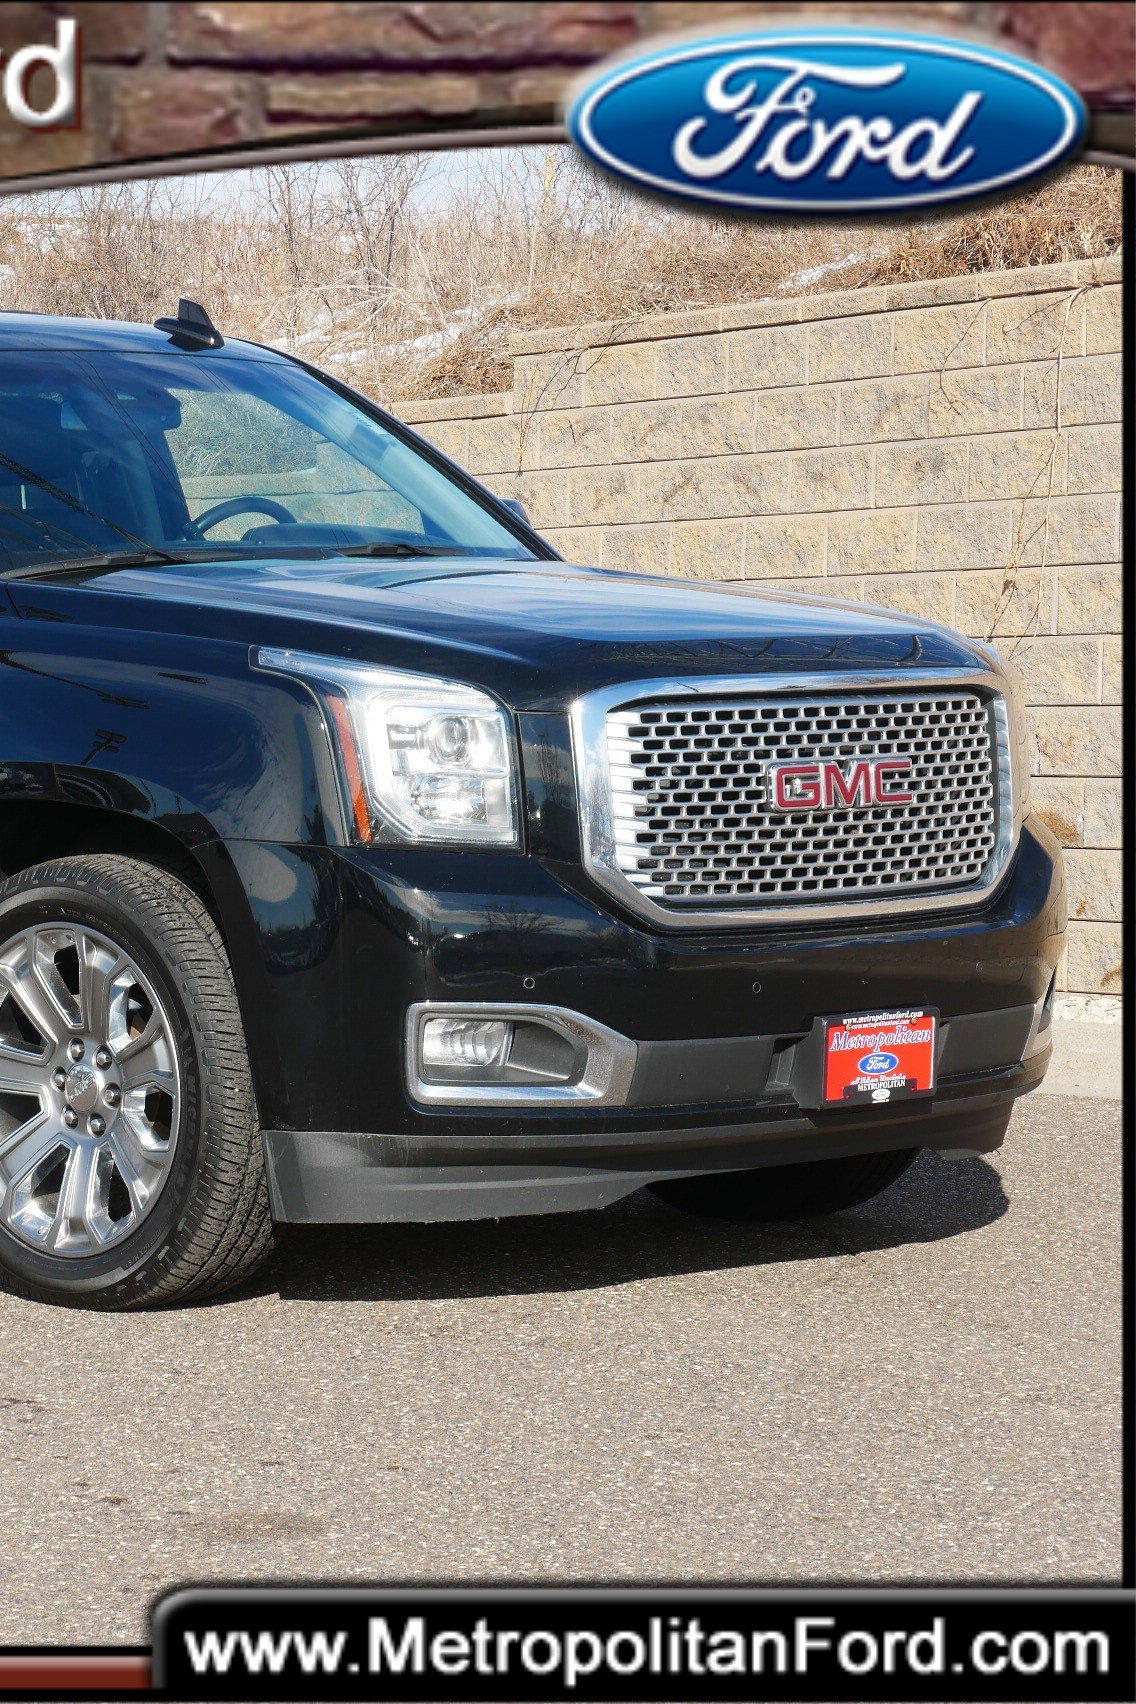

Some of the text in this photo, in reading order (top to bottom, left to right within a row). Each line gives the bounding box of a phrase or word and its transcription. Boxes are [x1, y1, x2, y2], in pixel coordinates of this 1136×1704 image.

[766, 756, 914, 812] GMC
[830, 1025, 931, 1052] Metropolitan
[866, 1056, 890, 1071] Ford
[857, 1079, 905, 1091] METROPOLITAN
